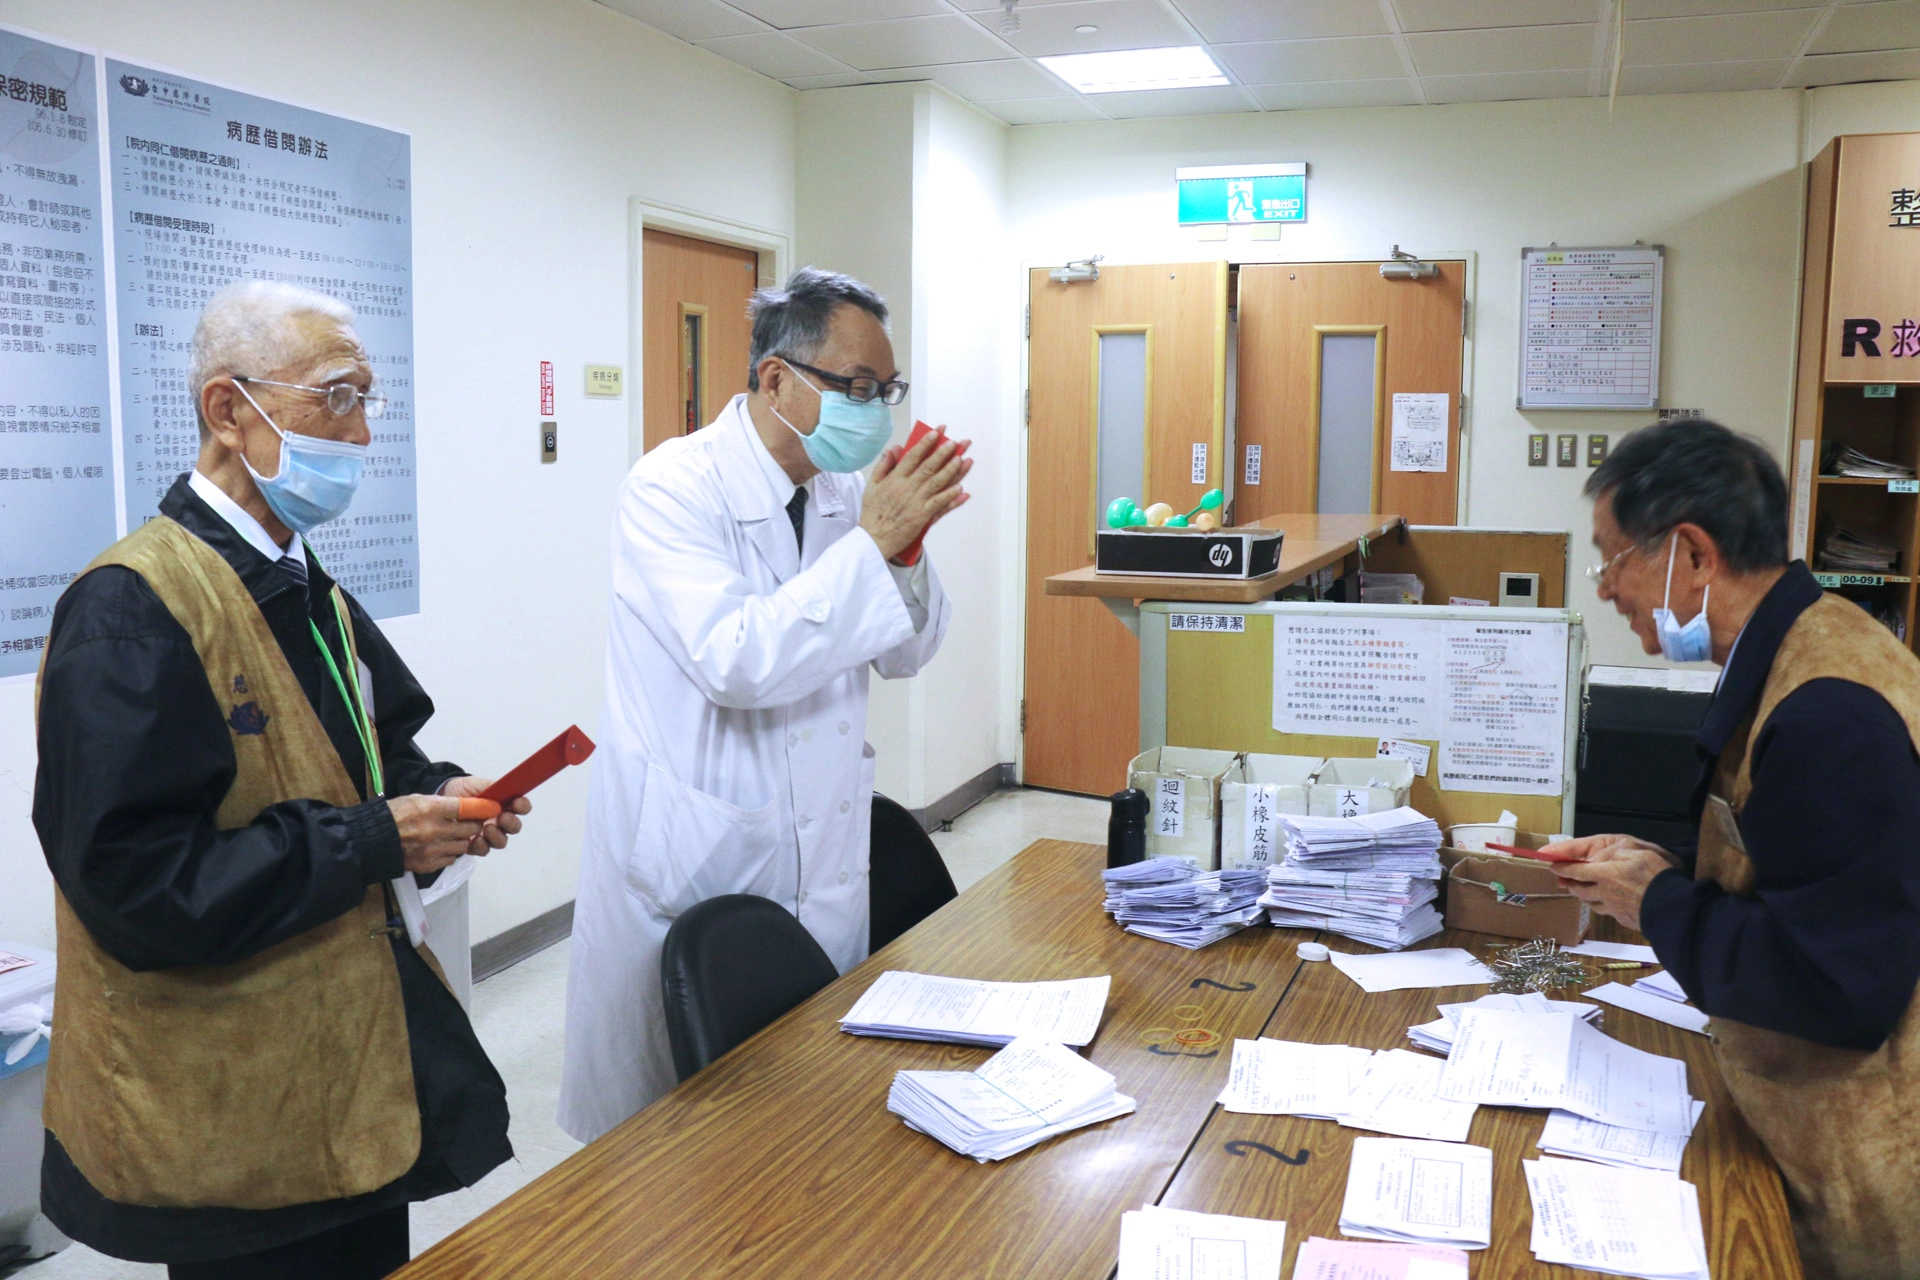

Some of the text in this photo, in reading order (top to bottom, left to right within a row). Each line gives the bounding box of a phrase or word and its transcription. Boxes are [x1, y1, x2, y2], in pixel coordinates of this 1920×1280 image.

[226, 120, 329, 161] 病歷借閱辦法
[0, 163, 86, 188] ，不得無故洩漏。
[1263, 209, 1299, 219] EXIT
[1888, 188, 1920, 228] 整
[0, 242, 92, 265] 務，非因業務所需，
[1841, 318, 1920, 358] R 救
[0, 572, 79, 591] 桶或當回收紙
[1842, 575, 1874, 585] 00-09
[1171, 614, 1244, 631] 請保持清潔
[0, 635, 48, 654] 予相當程
[1161, 779, 1180, 834] 迴紋針
[1251, 787, 1271, 862] 小橡皮筋
